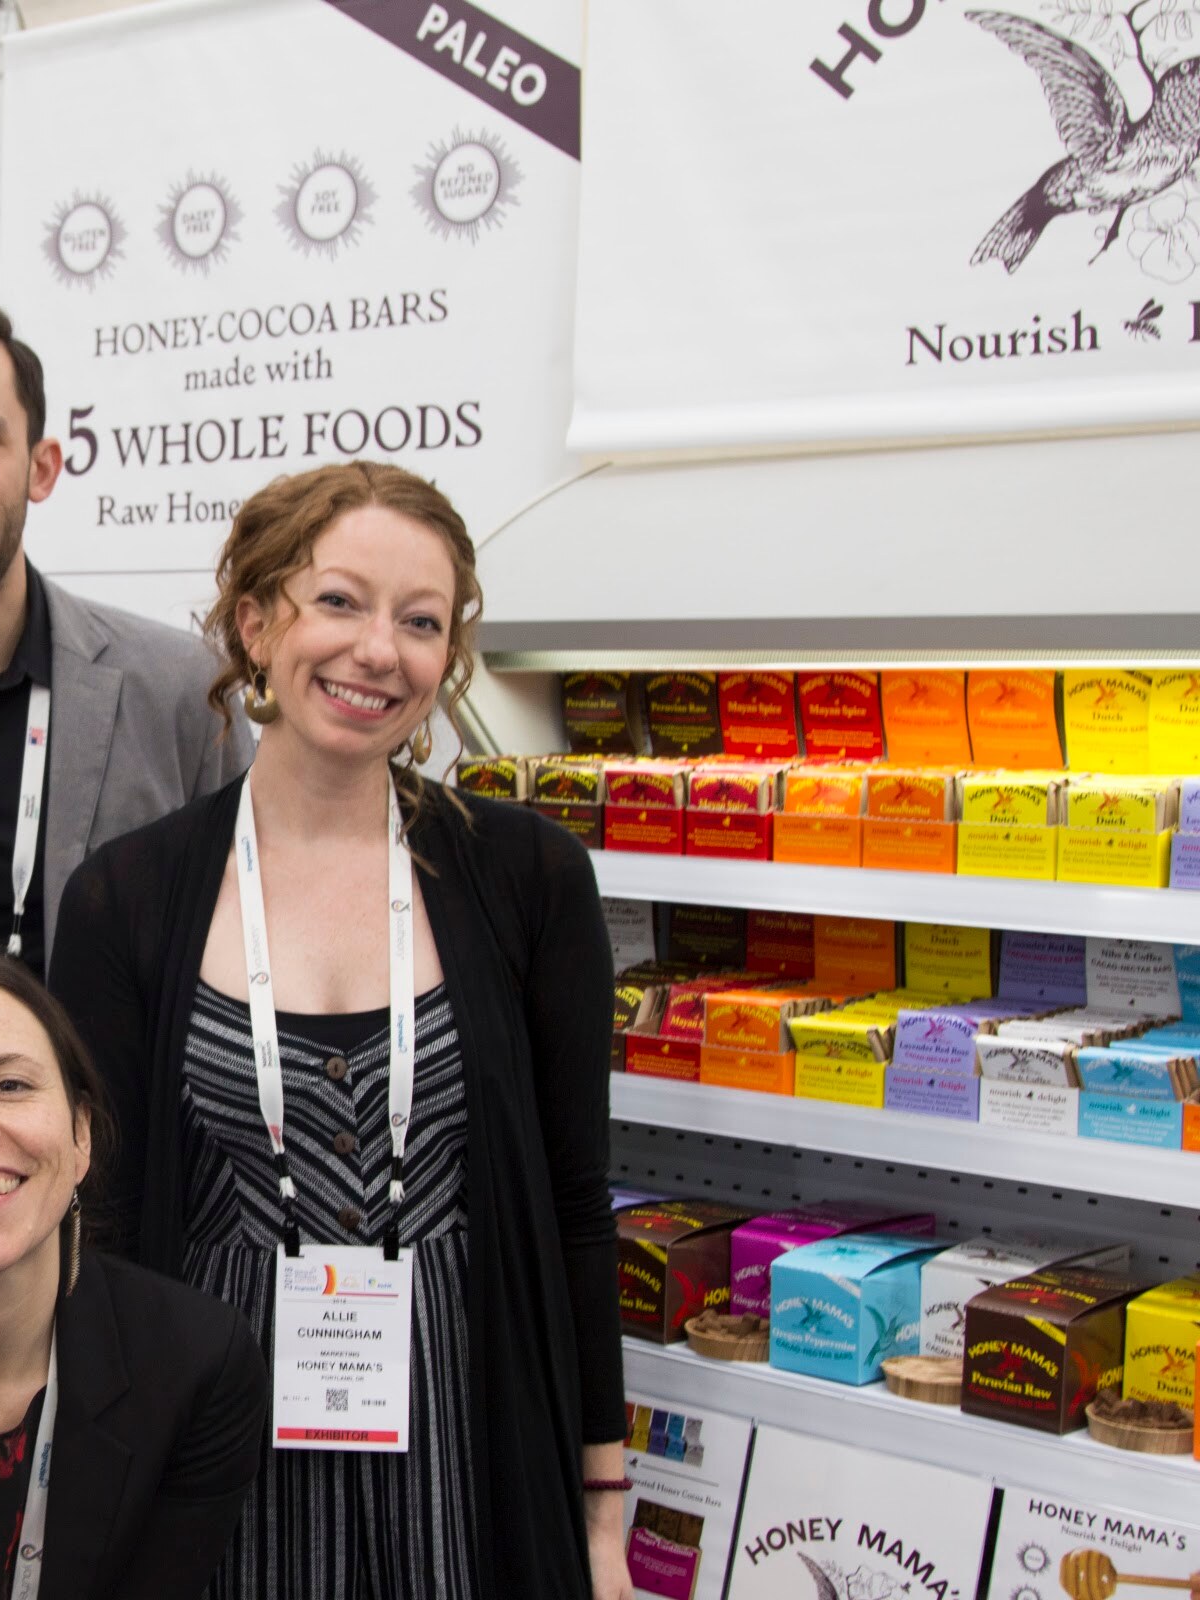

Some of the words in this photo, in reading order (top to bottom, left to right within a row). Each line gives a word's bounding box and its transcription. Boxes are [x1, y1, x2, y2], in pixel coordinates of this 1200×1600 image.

[416, 3, 548, 106] PALEO
[440, 172, 493, 188] REFINED
[314, 189, 338, 202] SOY
[443, 184, 488, 199] SUGARS
[311, 201, 340, 215] FREE
[94, 301, 337, 358] HONEY-COCOA
[349, 289, 449, 331] BARS
[904, 309, 1101, 366] Nourish
[184, 355, 256, 391] made
[266, 349, 333, 383] with
[64, 404, 98, 477] 5
[112, 414, 288, 467] WHOLE
[302, 400, 484, 456] FOODS
[97, 495, 158, 527] Raw
[167, 491, 240, 524] Hone
[809, 703, 841, 718] Mayan
[1092, 711, 1124, 722] Dutch
[1096, 815, 1126, 826] Dutch
[968, 832, 999, 841] nourish
[1014, 832, 1042, 844] delight
[1069, 837, 1102, 847] nourish
[1117, 839, 1148, 851] delight
[930, 934, 960, 946] Dutch
[1133, 953, 1163, 962] Coffee
[899, 1040, 934, 1052] Lavender
[935, 1046, 950, 1055] Red
[893, 1075, 923, 1087] nourish
[939, 1080, 966, 1093] delight
[989, 1088, 1022, 1099] nourish
[1038, 1092, 1067, 1105] delight
[1089, 1101, 1123, 1113] nourish
[1139, 1106, 1171, 1119] delight
[734, 1264, 767, 1283] HONEY
[635, 1297, 657, 1313] Raw
[774, 1296, 809, 1314] HONEY
[925, 1300, 960, 1317] HONEY
[322, 1310, 358, 1321] ALLIE
[297, 1328, 383, 1340] CUNNINGHAM
[772, 1326, 803, 1343] Oregon
[805, 1333, 857, 1353] Peppermint
[320, 1350, 360, 1358] MARKETING
[967, 1339, 1008, 1360] HONEY
[1130, 1343, 1170, 1361] HONEY
[297, 1360, 336, 1371] HONEY
[338, 1361, 383, 1373] MAMA'S
[971, 1370, 1022, 1395] Peruvian
[1024, 1381, 1053, 1401] Raw
[1157, 1380, 1193, 1397] Dutch
[304, 1429, 369, 1442] EXHIBITOR
[657, 1482, 681, 1499] Honey
[1028, 1498, 1097, 1528] HONEY
[1104, 1517, 1187, 1551] MAMA'S
[745, 1516, 843, 1566] HONEY
[1061, 1524, 1096, 1542] Nourish
[1110, 1537, 1142, 1554] Delight
